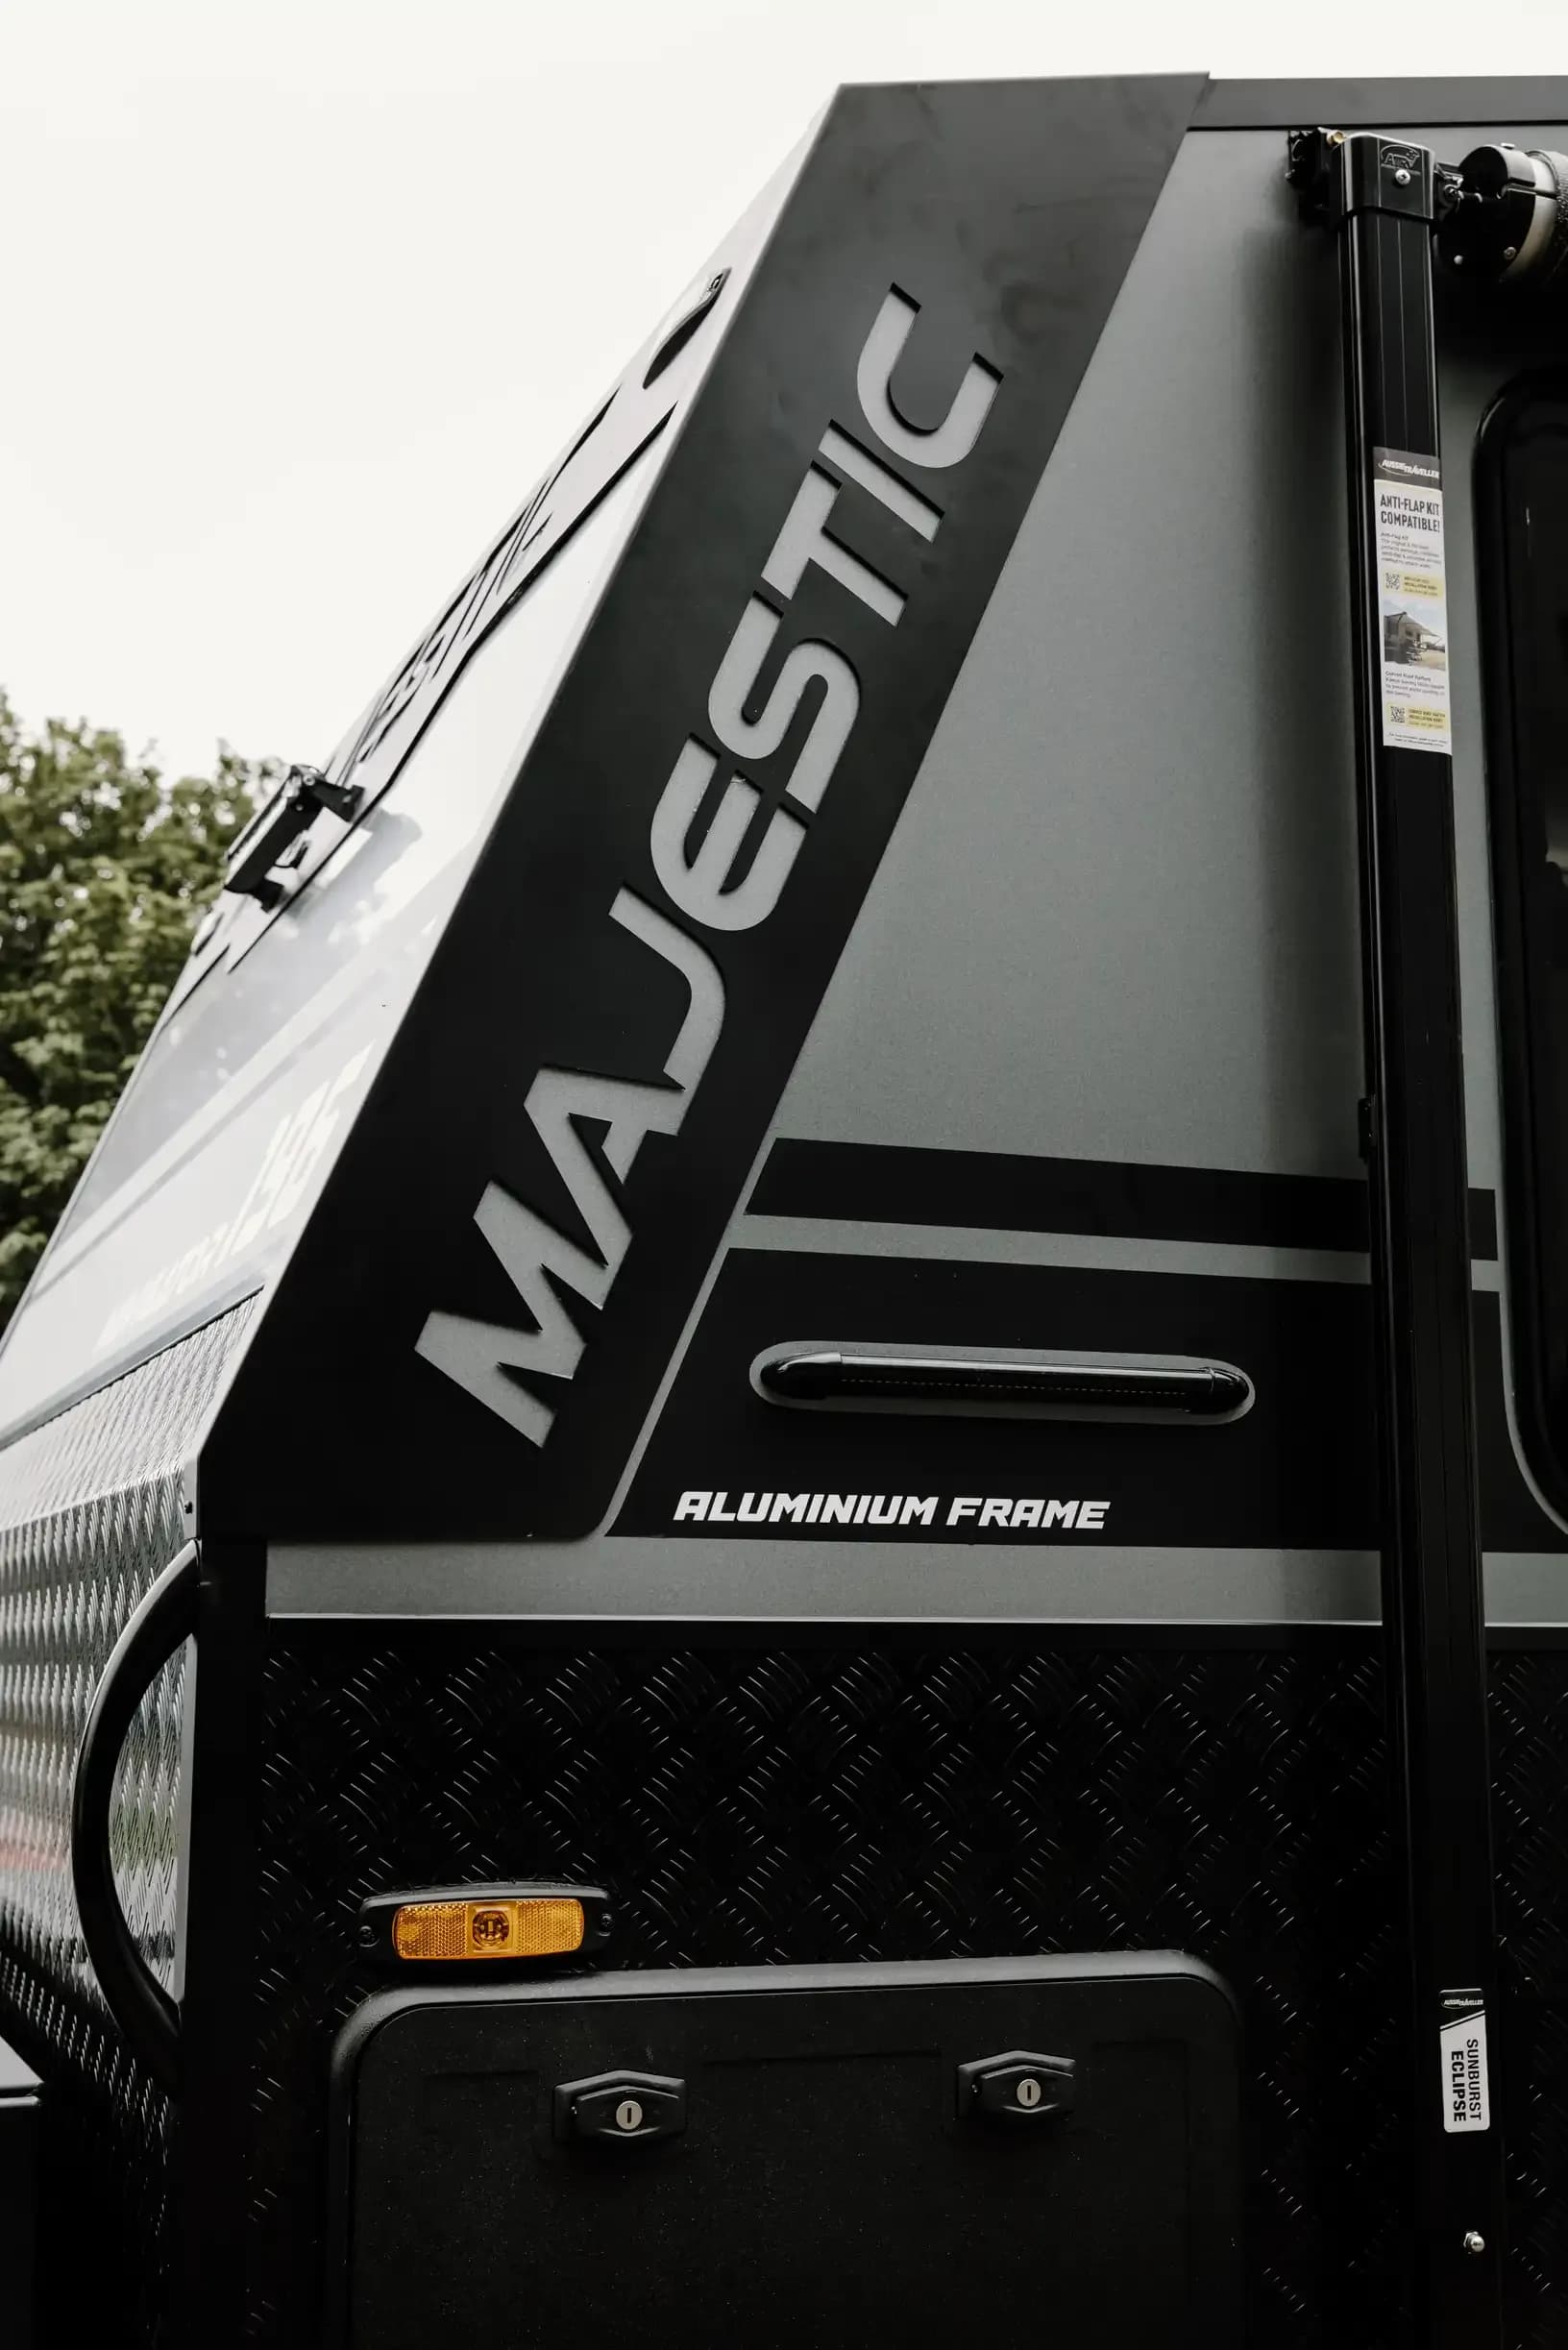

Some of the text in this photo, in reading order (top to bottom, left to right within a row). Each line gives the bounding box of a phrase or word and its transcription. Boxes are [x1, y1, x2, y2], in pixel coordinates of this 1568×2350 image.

[1381, 494, 1440, 516] ANTI-FLAP KIT
[1381, 510, 1440, 533] COMPATIBLE!
[414, 282, 1004, 1449] MAJESTIC
[674, 1491, 1111, 1530] ALUMINIUM FRAME
[1451, 2050, 1466, 2121] ECLIPSE
[1467, 2039, 1481, 2120] SUNBURST
